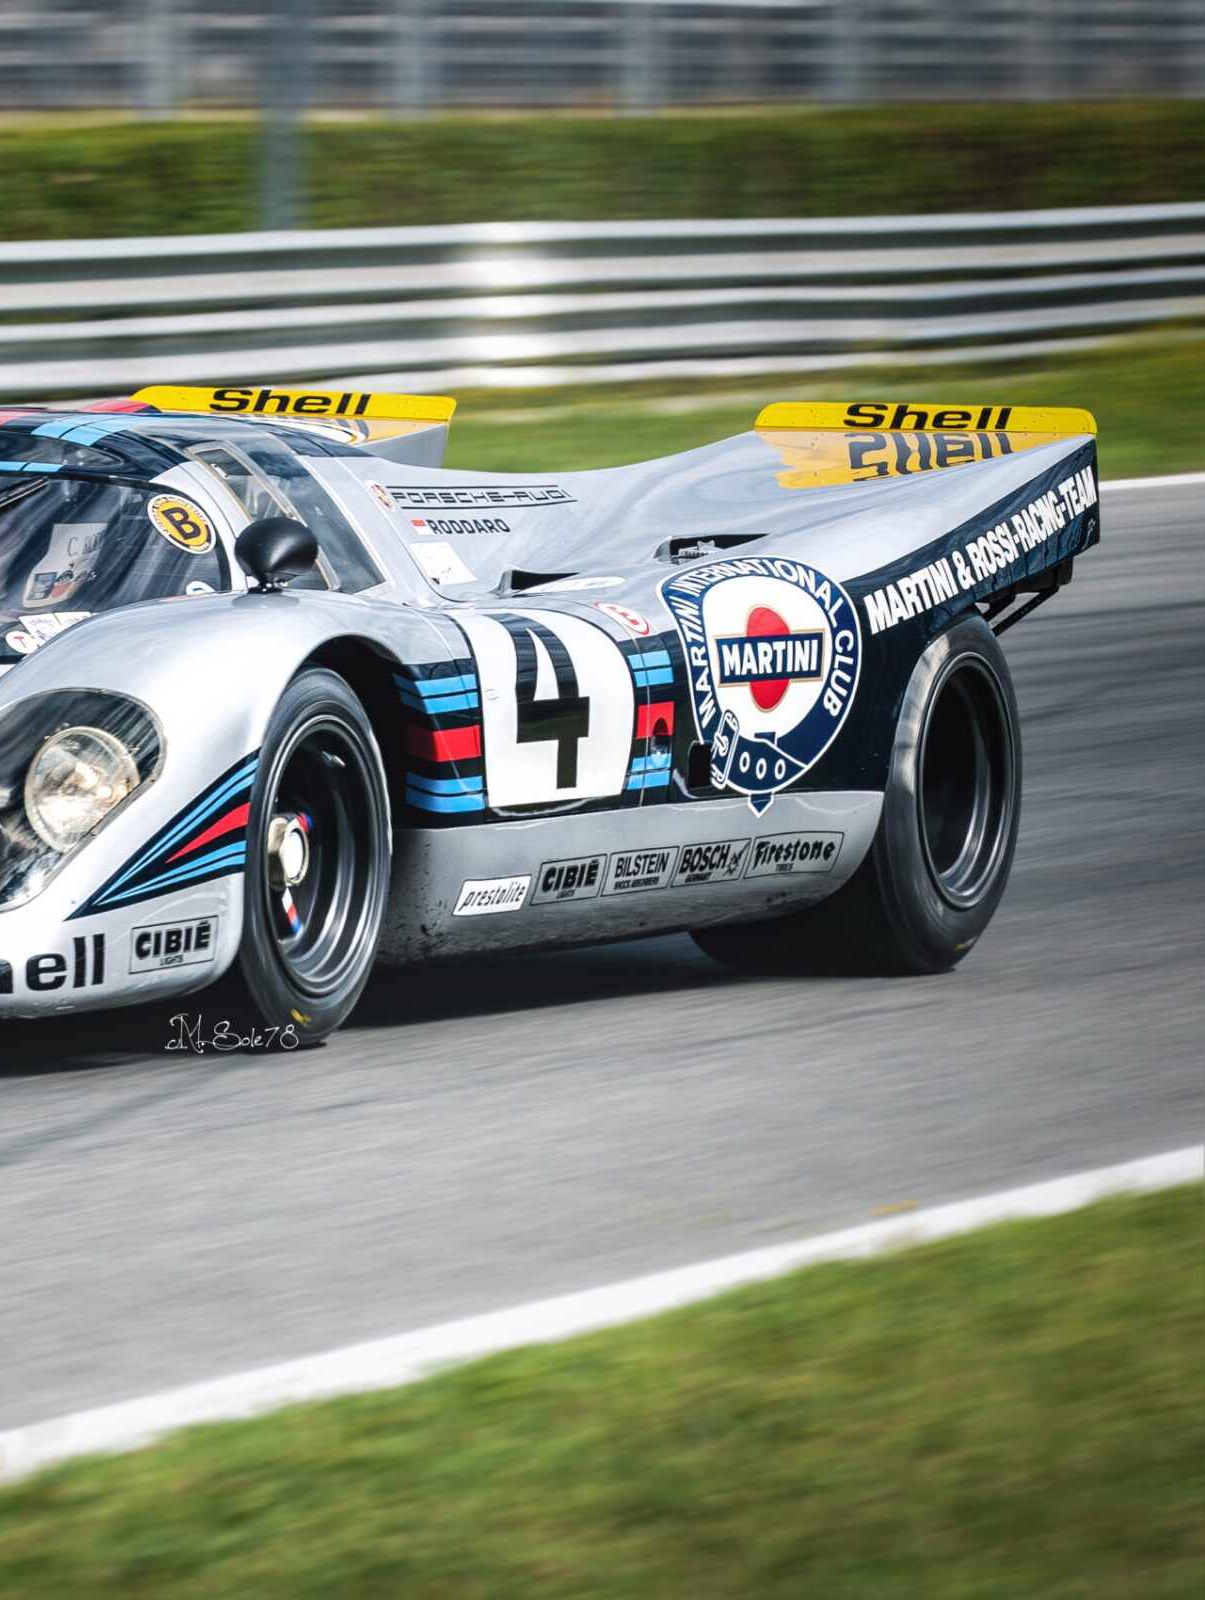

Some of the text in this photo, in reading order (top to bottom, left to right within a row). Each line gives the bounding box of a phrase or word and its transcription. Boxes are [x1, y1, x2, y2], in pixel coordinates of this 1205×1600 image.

[209, 388, 372, 415] Shell
[843, 402, 1013, 430] Shell
[391, 488, 572, 504] PORSCHE-AUDI
[160, 506, 201, 541] B
[426, 518, 512, 535] RODDARO
[863, 557, 959, 635] MARTINI
[952, 550, 976, 590] &
[669, 558, 855, 729] MARTINI INTERNATIONAL CLUB
[721, 639, 819, 677] MARTINI
[483, 612, 590, 790] 4
[614, 852, 670, 879] BILSTEIN
[679, 843, 732, 874] BOSCH
[753, 837, 836, 870] Firestone
[458, 880, 526, 912] prestolite
